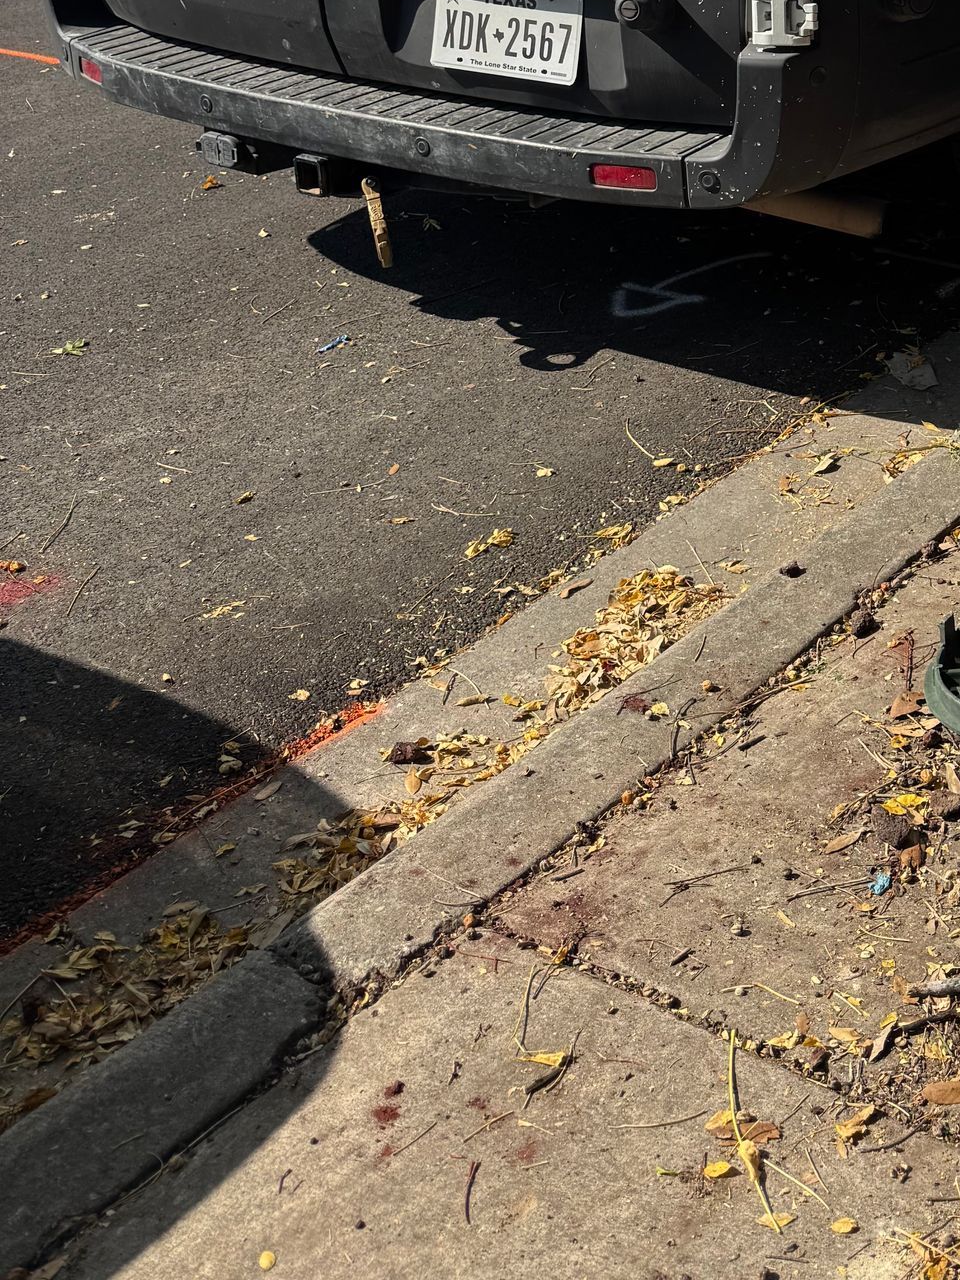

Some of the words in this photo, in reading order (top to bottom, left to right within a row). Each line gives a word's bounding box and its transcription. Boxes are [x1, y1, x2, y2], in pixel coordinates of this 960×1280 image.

[470, 58, 483, 66] The
[484, 60, 501, 69] Lone
[502, 63, 517, 71] Star
[518, 65, 537, 73] State
